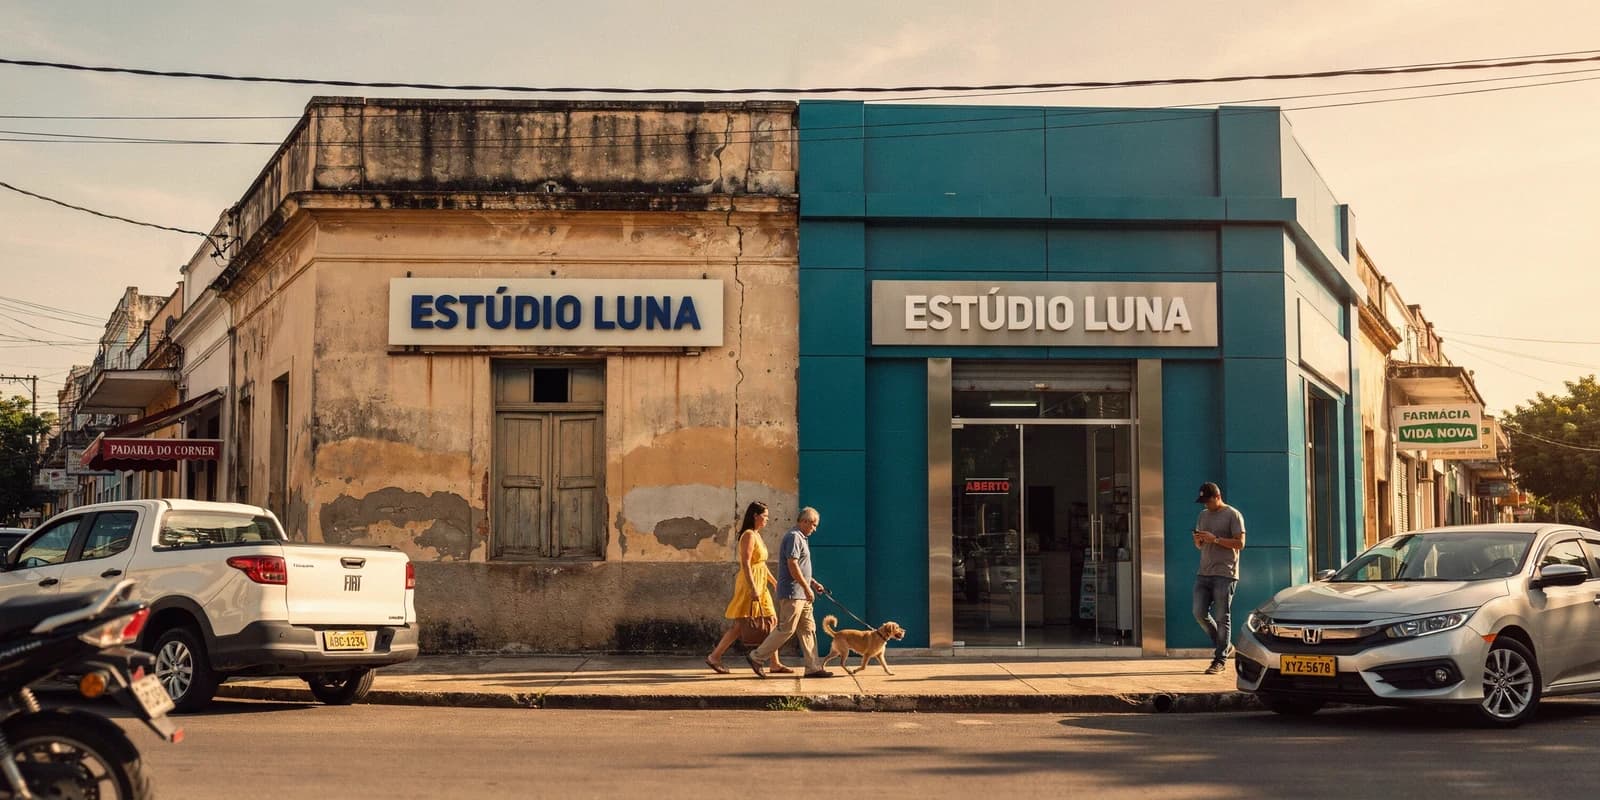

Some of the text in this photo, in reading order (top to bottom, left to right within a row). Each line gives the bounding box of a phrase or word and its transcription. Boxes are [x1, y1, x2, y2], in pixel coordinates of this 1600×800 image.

[410, 286, 702, 330] ESTÚDIO LUNA
[905, 287, 1192, 332] ESTÚDIO LUNA
[1402, 408, 1471, 421] FARMÁCIA
[1402, 426, 1474, 439] VIDA NOVA
[111, 444, 215, 456] PADARIA DO CORNER
[965, 480, 1010, 492] ABERTO
[343, 575, 362, 592] FIAT
[329, 635, 366, 648] ABC-1234
[1284, 659, 1332, 674] XYZ-5678
